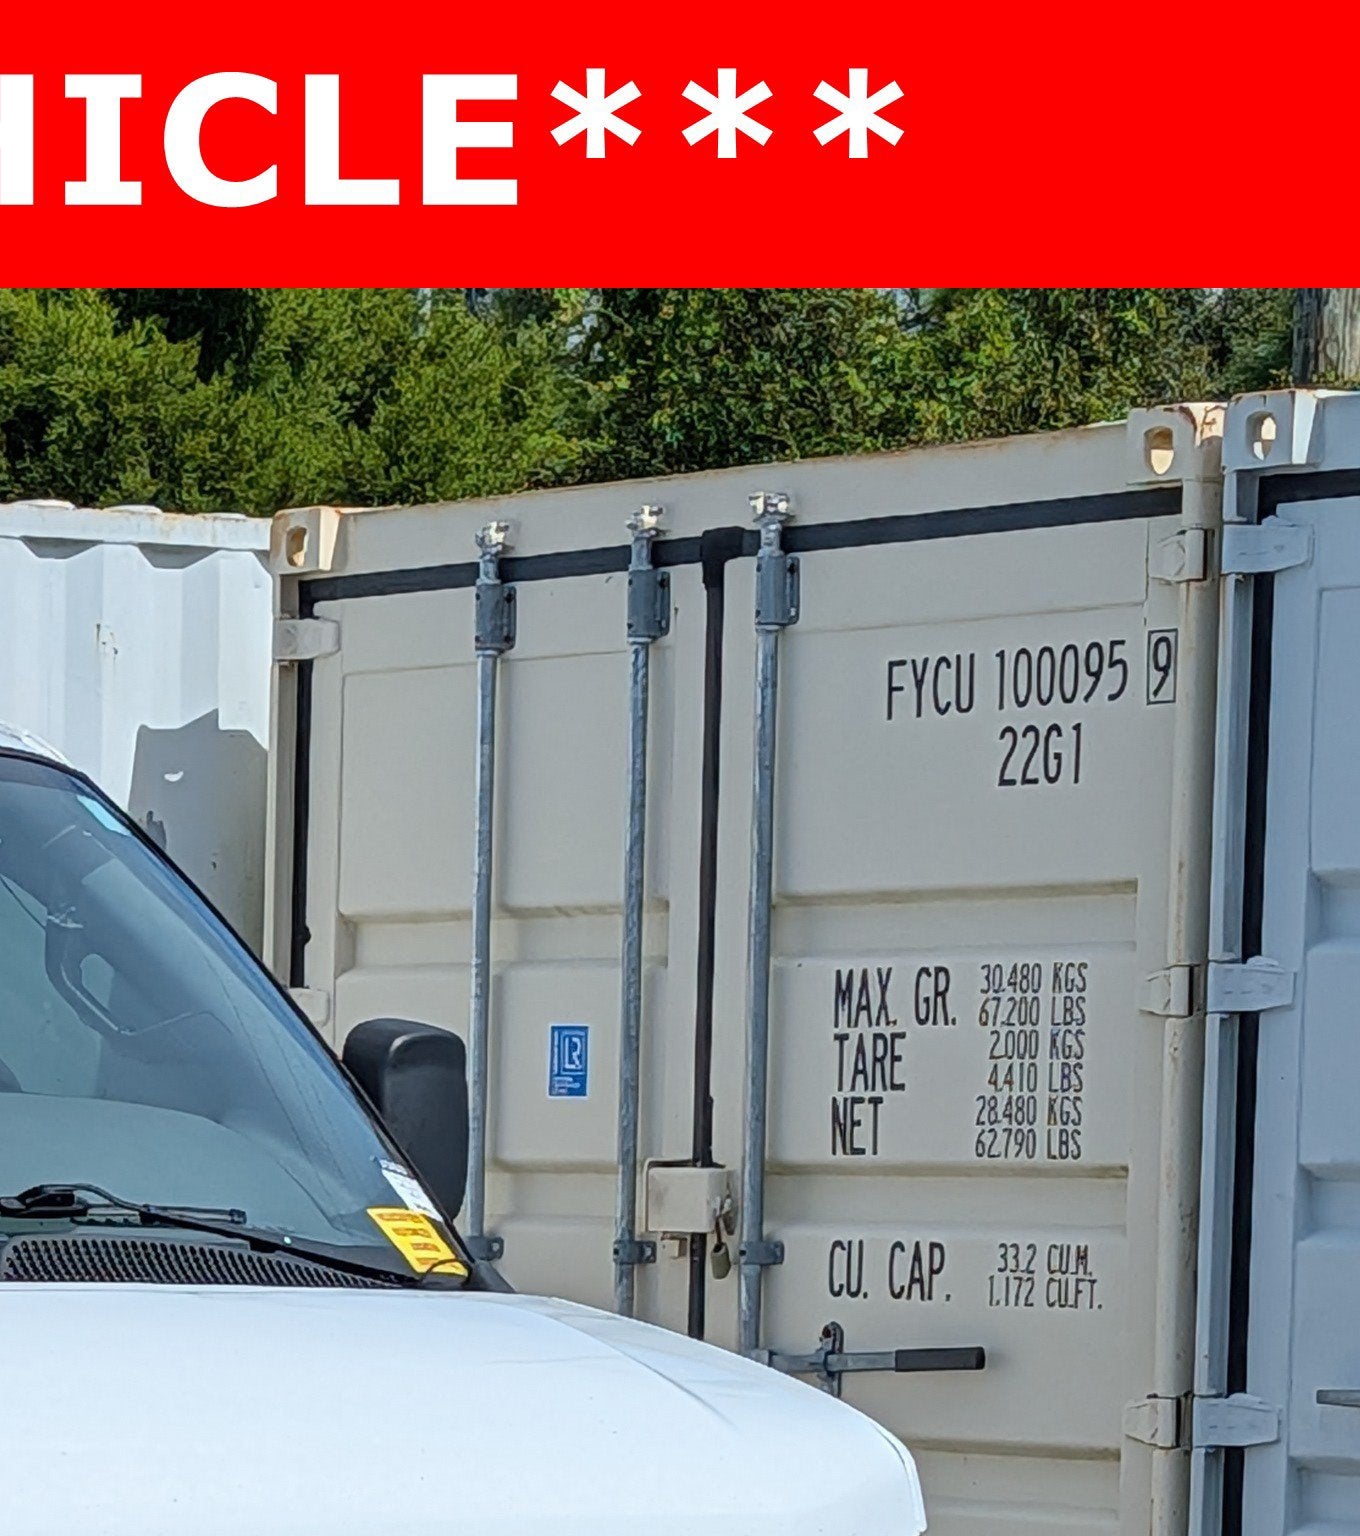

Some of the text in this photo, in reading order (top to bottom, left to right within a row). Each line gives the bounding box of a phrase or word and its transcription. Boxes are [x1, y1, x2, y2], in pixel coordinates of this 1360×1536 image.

[886, 636, 1173, 721] FYCU 100095 9
[997, 722, 1083, 787] 22G1
[1051, 961, 1089, 994] KGS
[833, 966, 957, 1029] MAX. GR.
[1050, 995, 1087, 1027] LBS
[1048, 1028, 1086, 1061] KGS
[833, 1031, 907, 1092] TARE
[1048, 1061, 1085, 1093] LBS
[831, 1096, 884, 1156] NET
[1046, 1095, 1084, 1127] KGS
[1046, 1128, 1083, 1160] LBS
[829, 1239, 952, 1302] CU. CAP.
[997, 1242, 1038, 1274] 33.2
